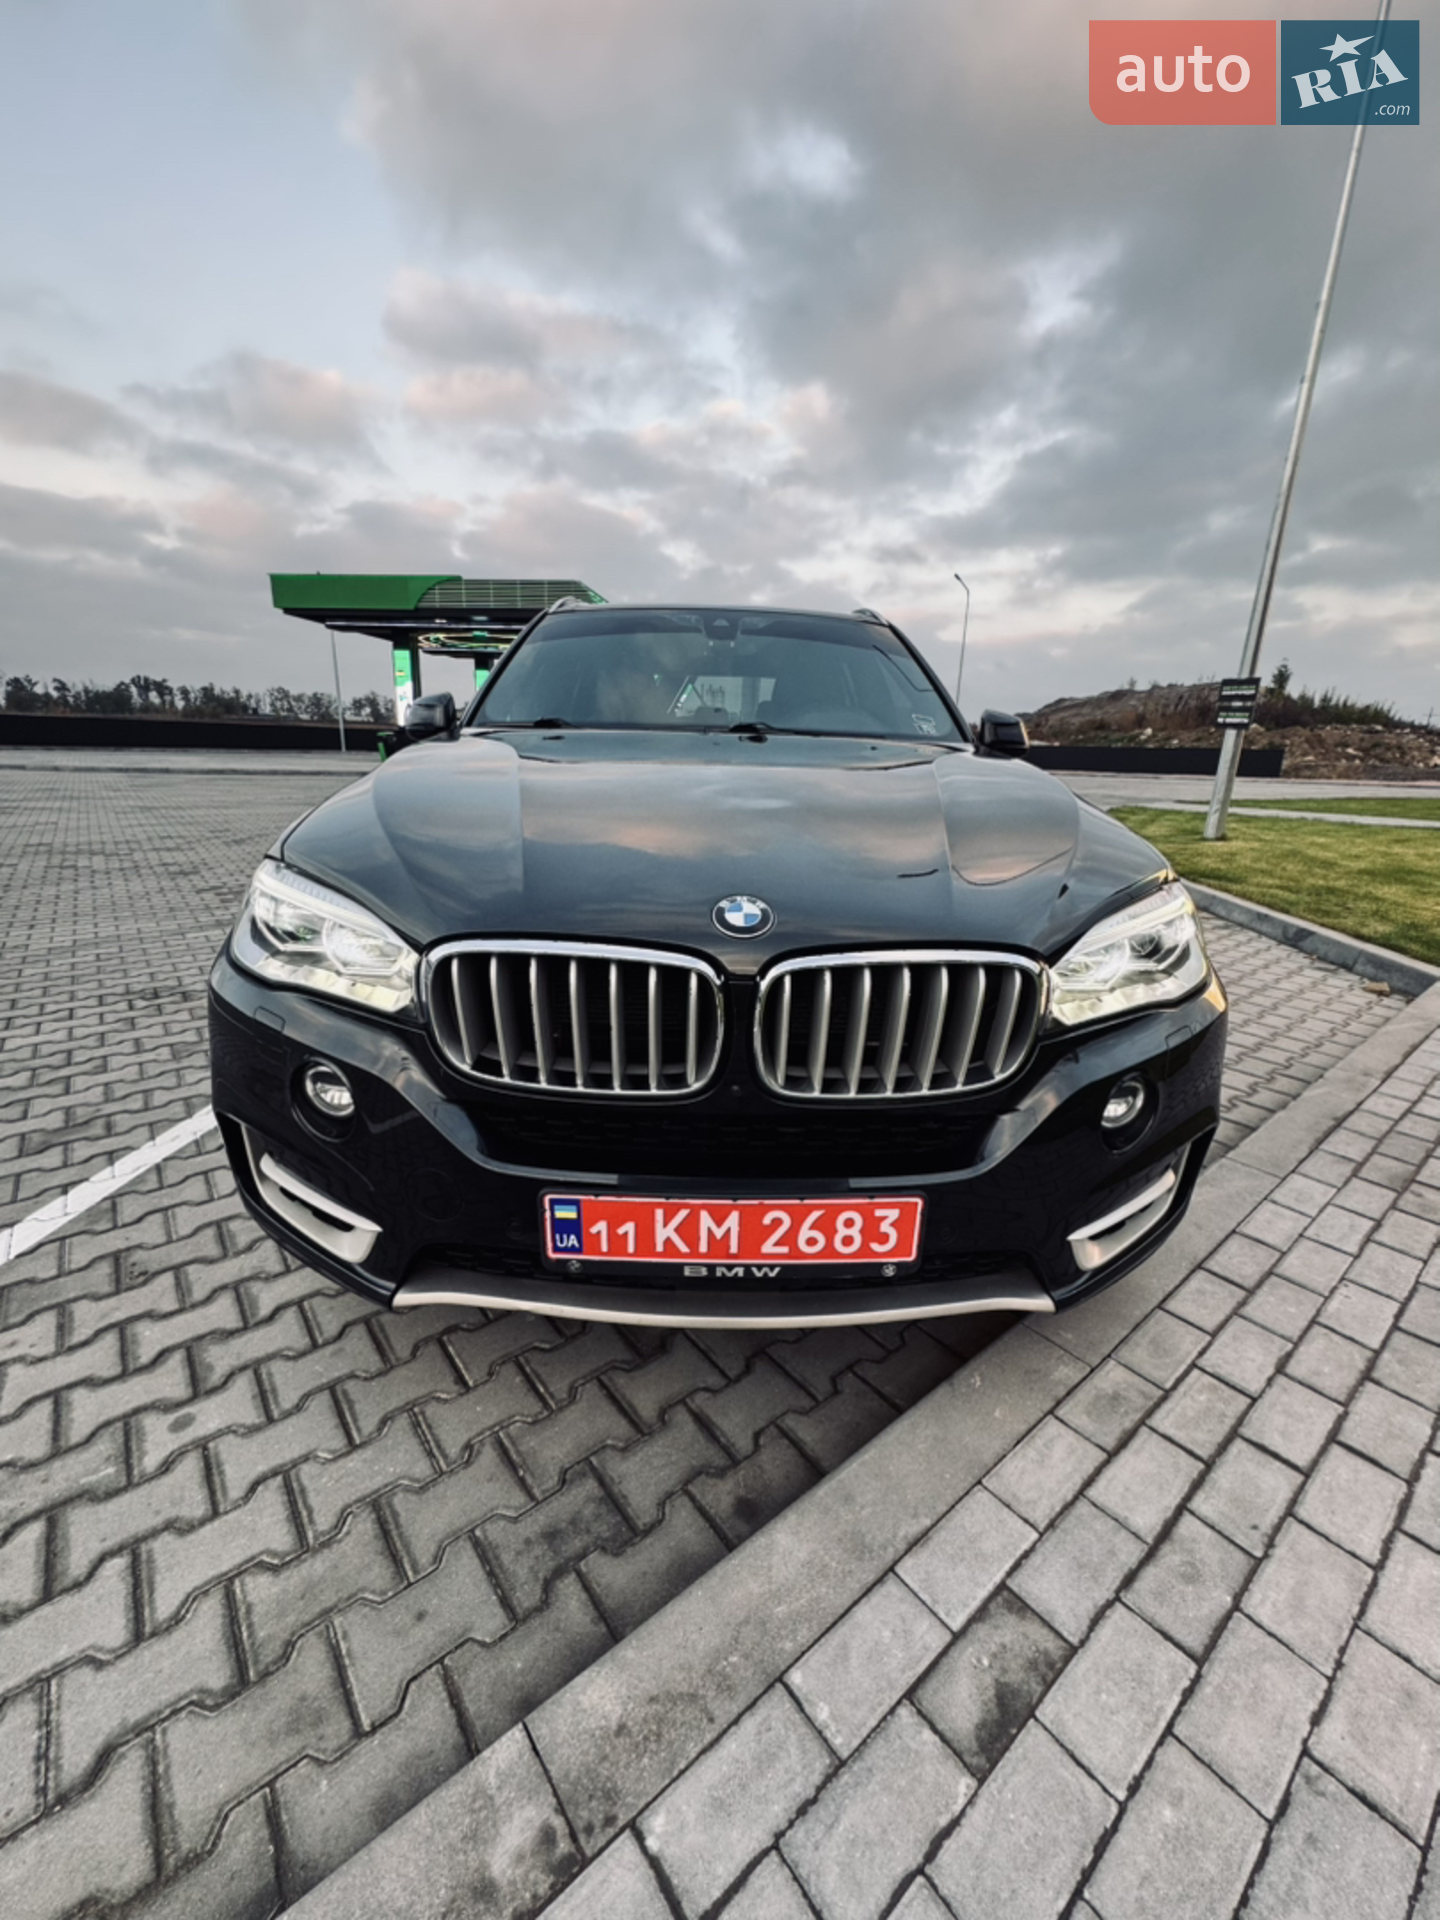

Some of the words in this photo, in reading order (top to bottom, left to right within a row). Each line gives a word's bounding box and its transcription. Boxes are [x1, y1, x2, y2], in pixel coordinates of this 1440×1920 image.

[589, 1220, 636, 1254] 11
[654, 1208, 741, 1254] KM
[760, 1208, 901, 1255] 2683
[555, 1233, 580, 1249] UA
[683, 1266, 782, 1278] BMW
